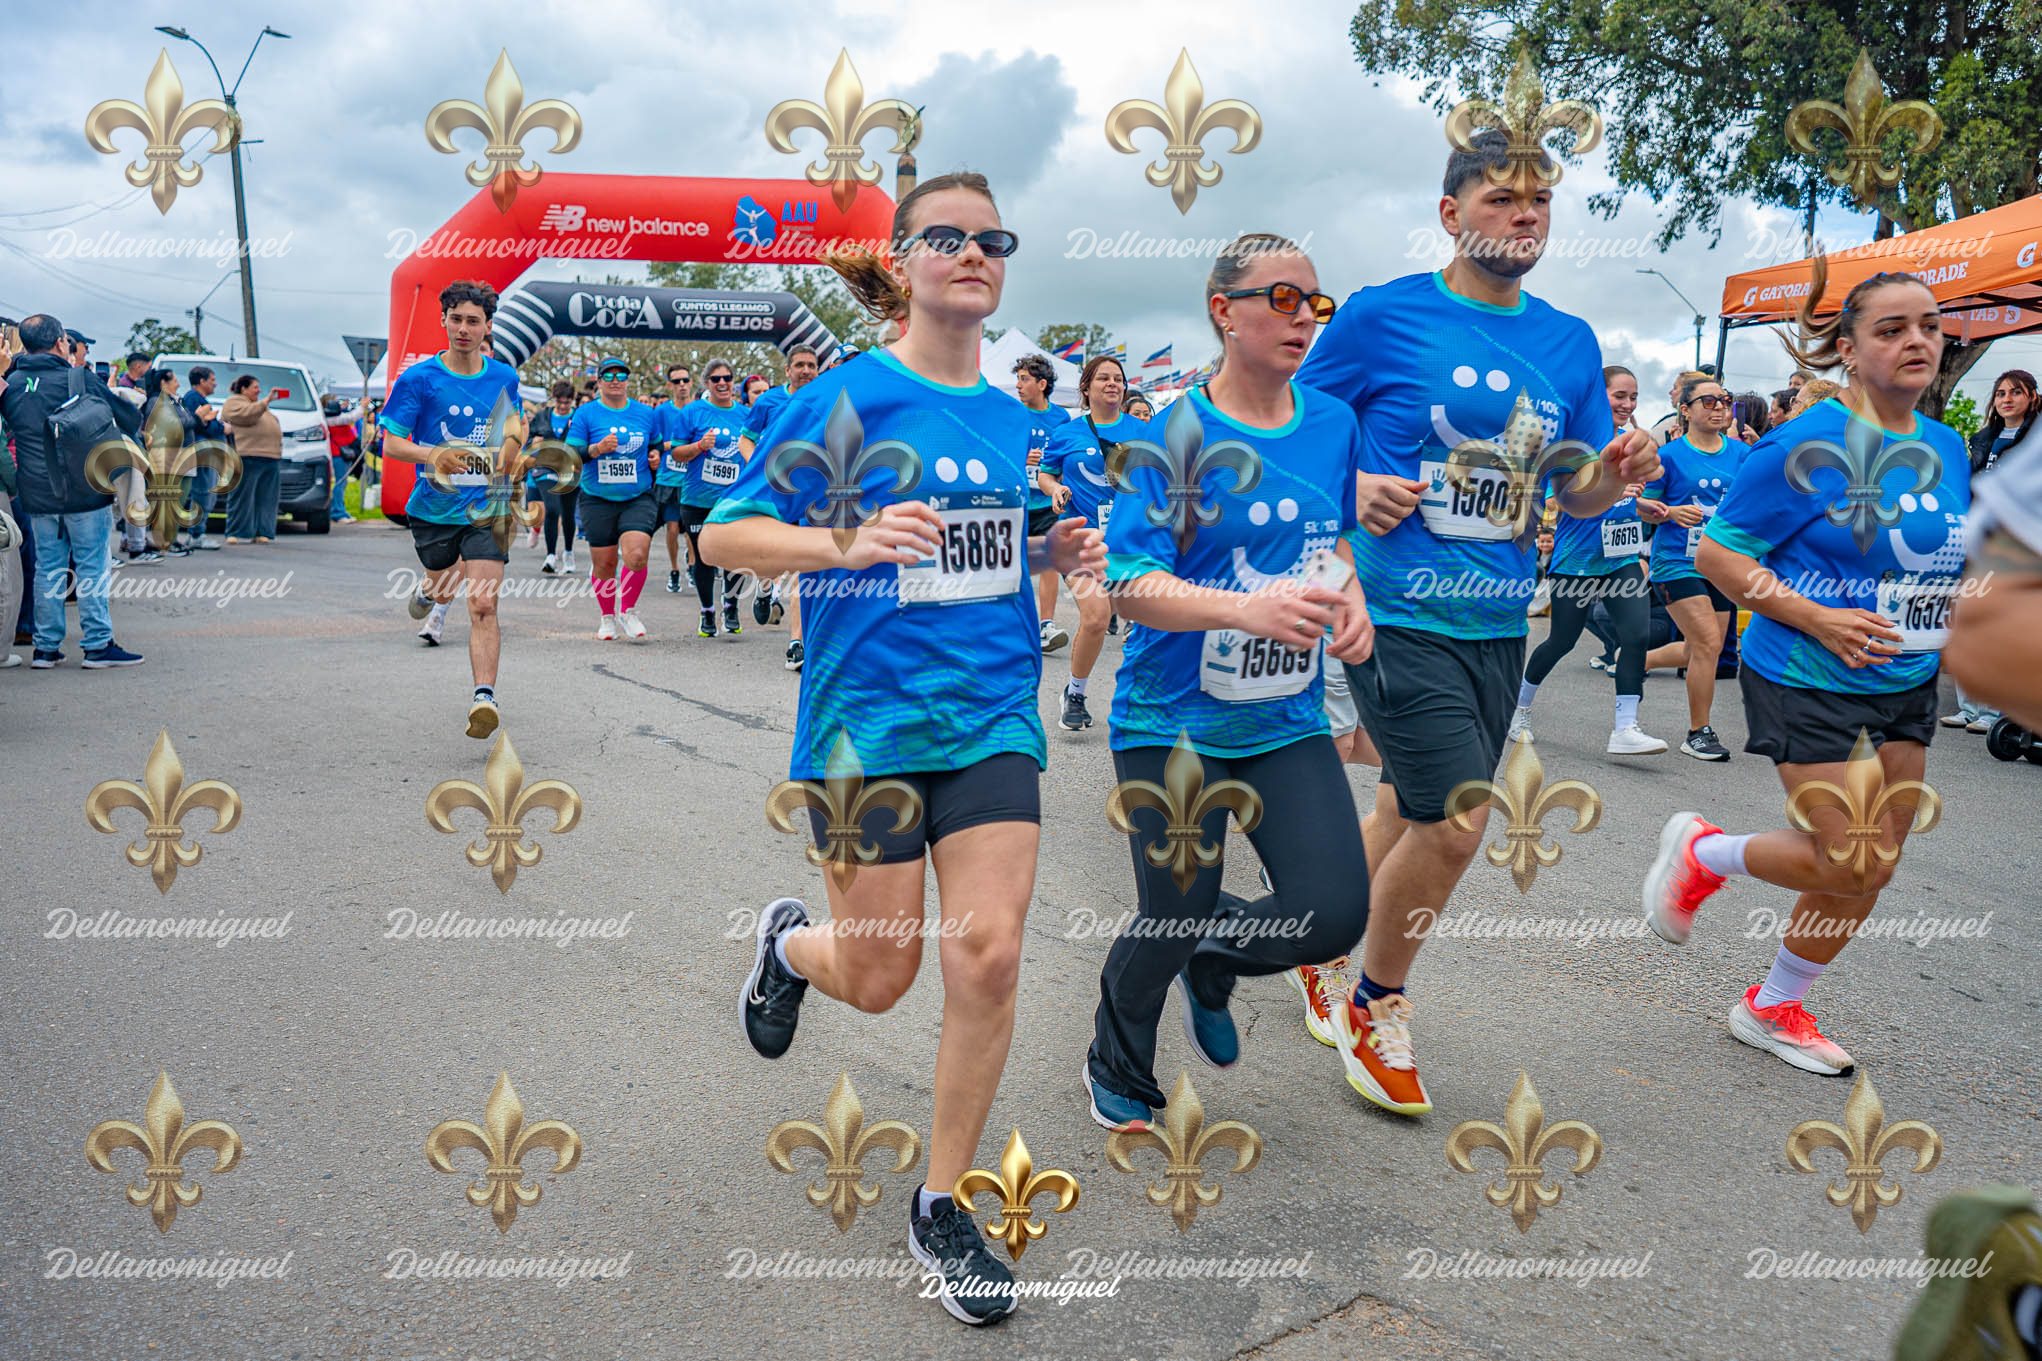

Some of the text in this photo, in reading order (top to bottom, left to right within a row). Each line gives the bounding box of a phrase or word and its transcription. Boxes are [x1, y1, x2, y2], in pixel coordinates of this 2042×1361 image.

[781, 201, 817, 222] AAU
[586, 215, 710, 237] new balance
[1760, 281, 1812, 302] GATORA
[678, 302, 771, 313] JUNTOS LLEGAMOS
[674, 313, 775, 331] MÁS LEJOS
[608, 462, 635, 477] 15992
[712, 464, 737, 480] 15991
[937, 519, 1013, 575] 15883
[1611, 526, 1639, 547] 16679
